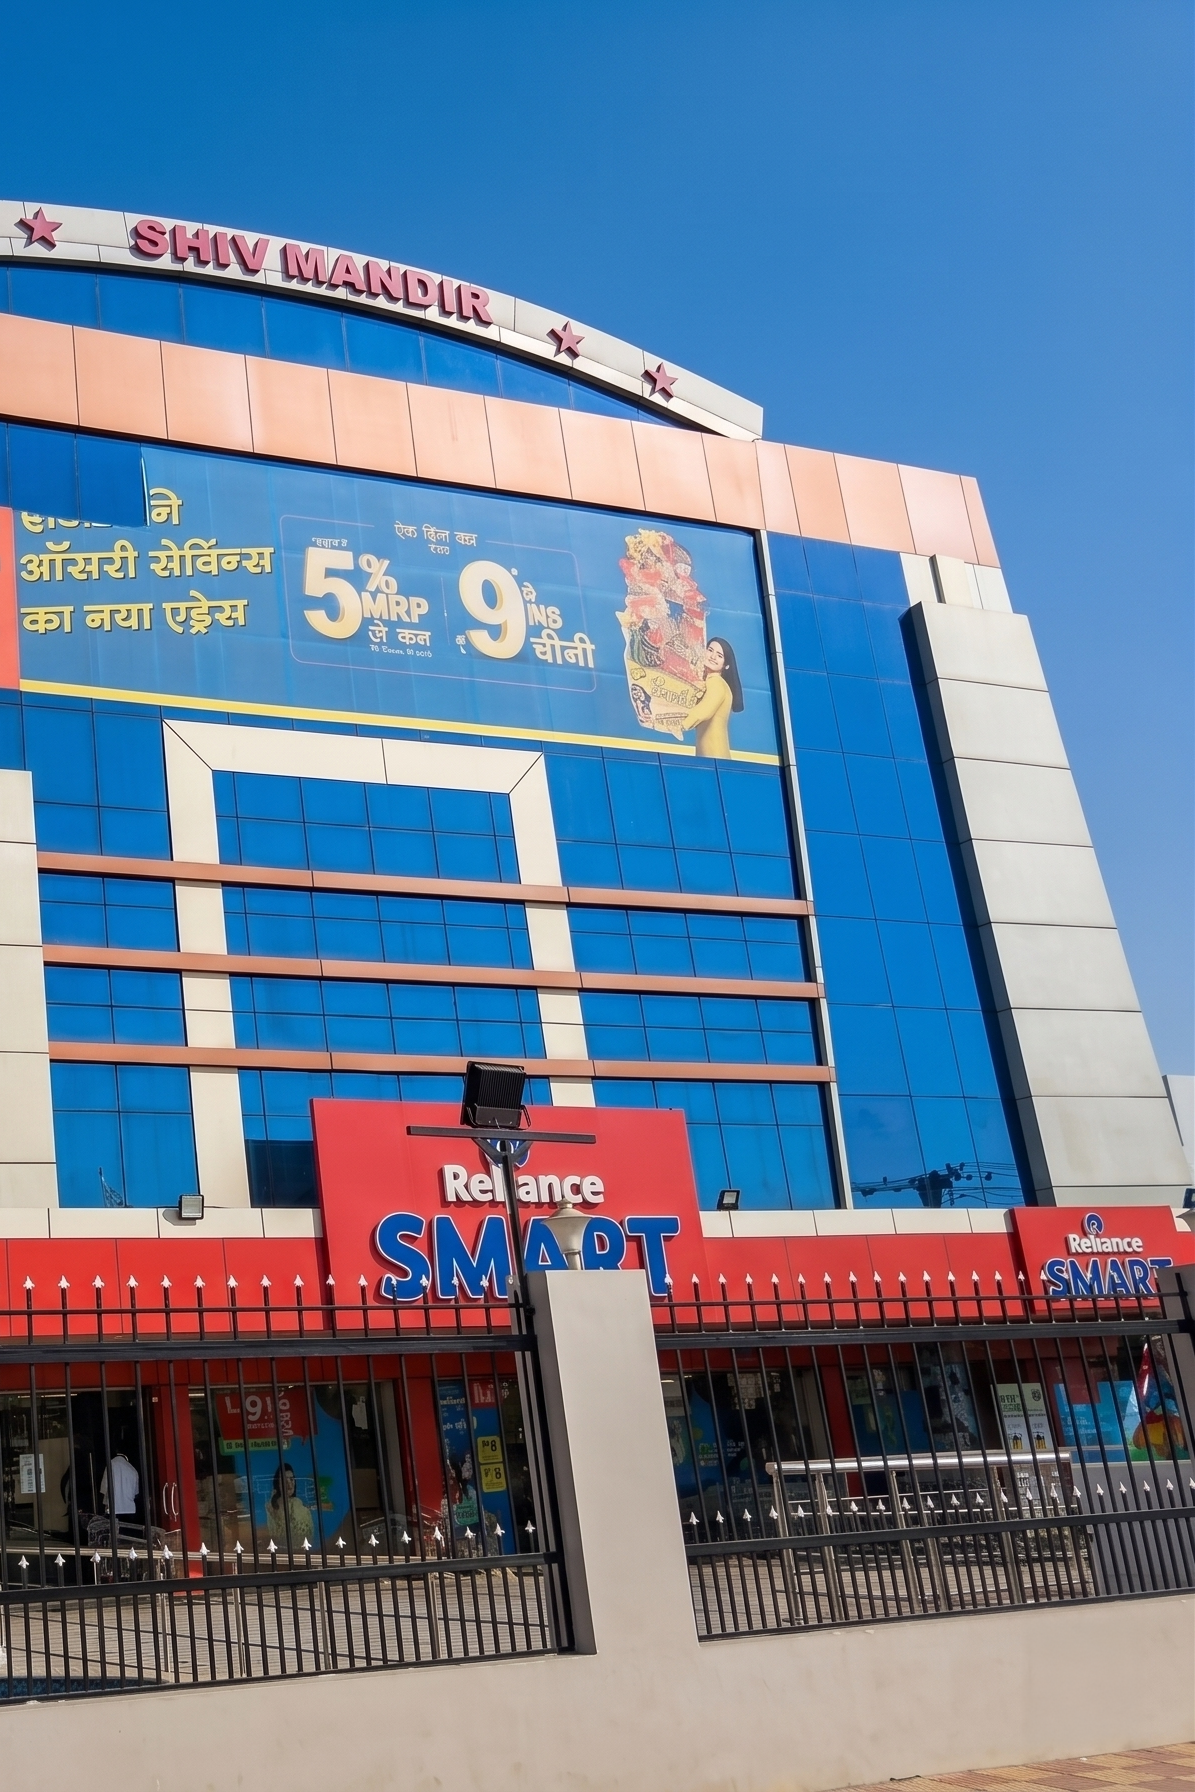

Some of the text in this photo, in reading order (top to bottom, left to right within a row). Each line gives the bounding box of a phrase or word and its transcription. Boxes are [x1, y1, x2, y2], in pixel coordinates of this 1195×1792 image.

[132, 219, 494, 325] SHIV MANDIR
[20, 590, 249, 635] का नया एड्रेस
[361, 591, 429, 623] MRP
[458, 560, 526, 660] 9
[530, 628, 595, 669] चीनी
[442, 1164, 605, 1204] Relance
[1068, 1234, 1143, 1254] Reliance
